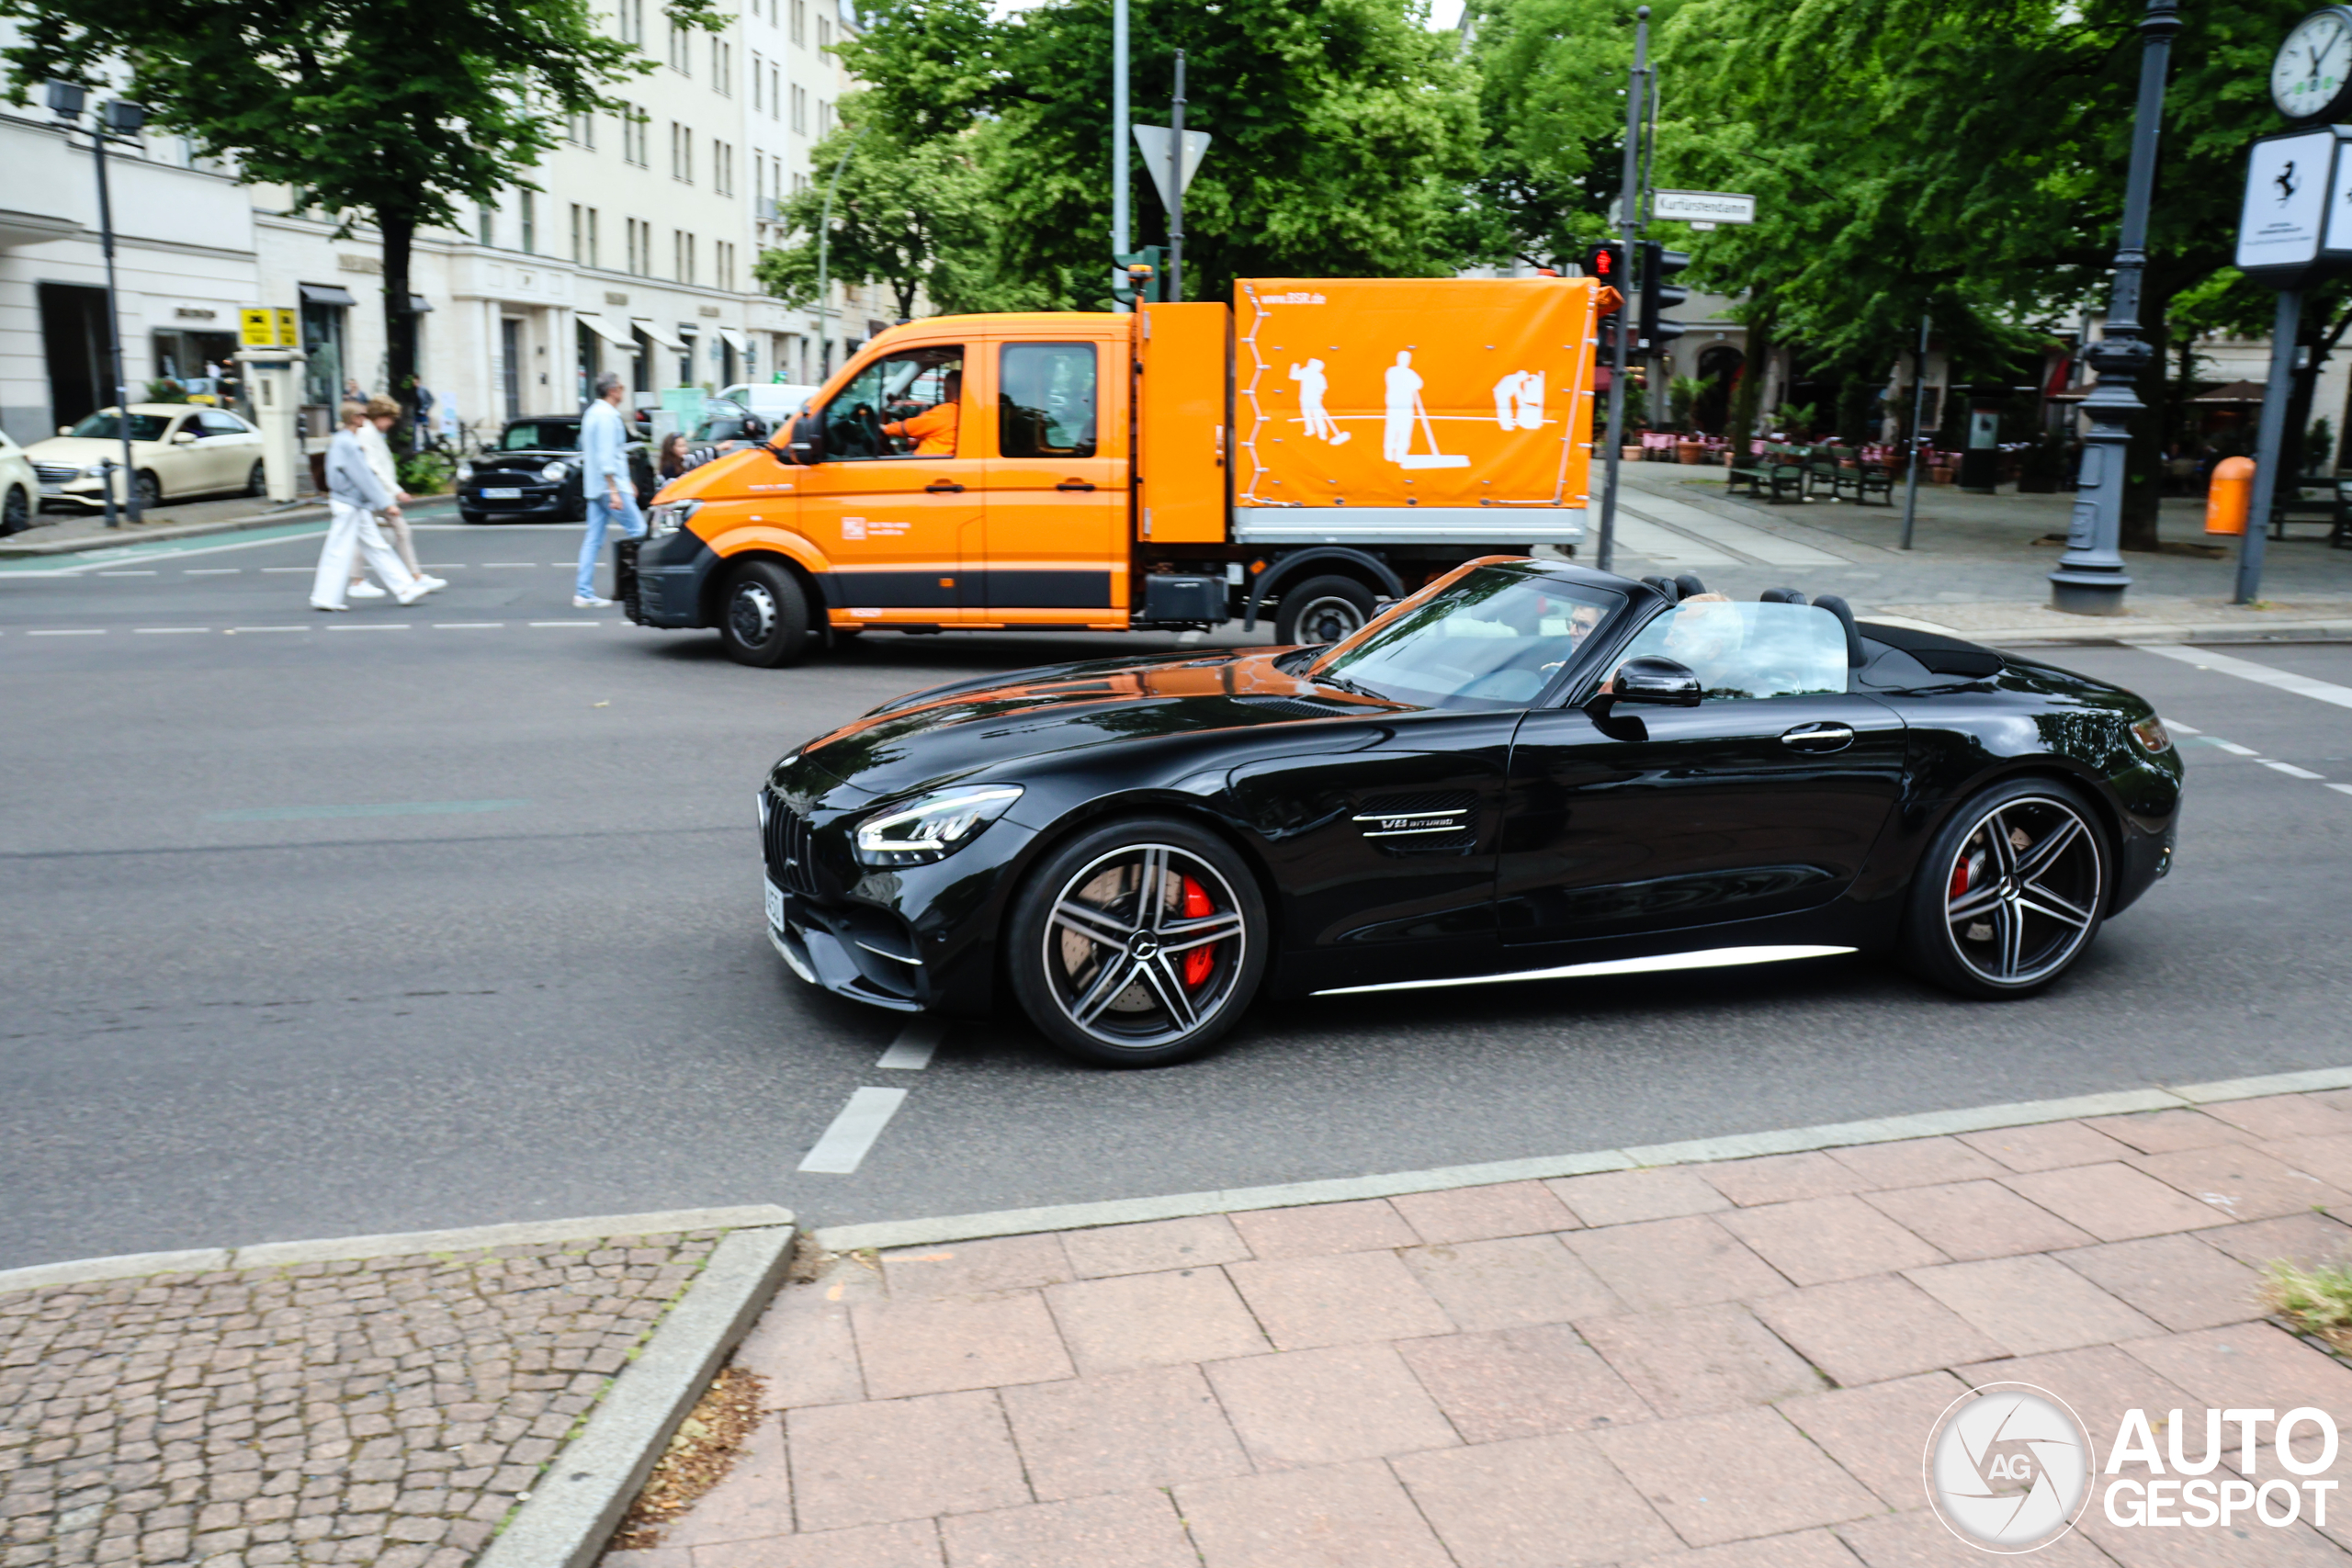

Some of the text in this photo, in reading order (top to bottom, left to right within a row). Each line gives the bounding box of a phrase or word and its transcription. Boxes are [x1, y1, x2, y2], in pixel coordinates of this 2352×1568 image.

[1260, 292, 1327, 304] www.BSR.de
[1381, 818, 1453, 829] V8 BITURBO
